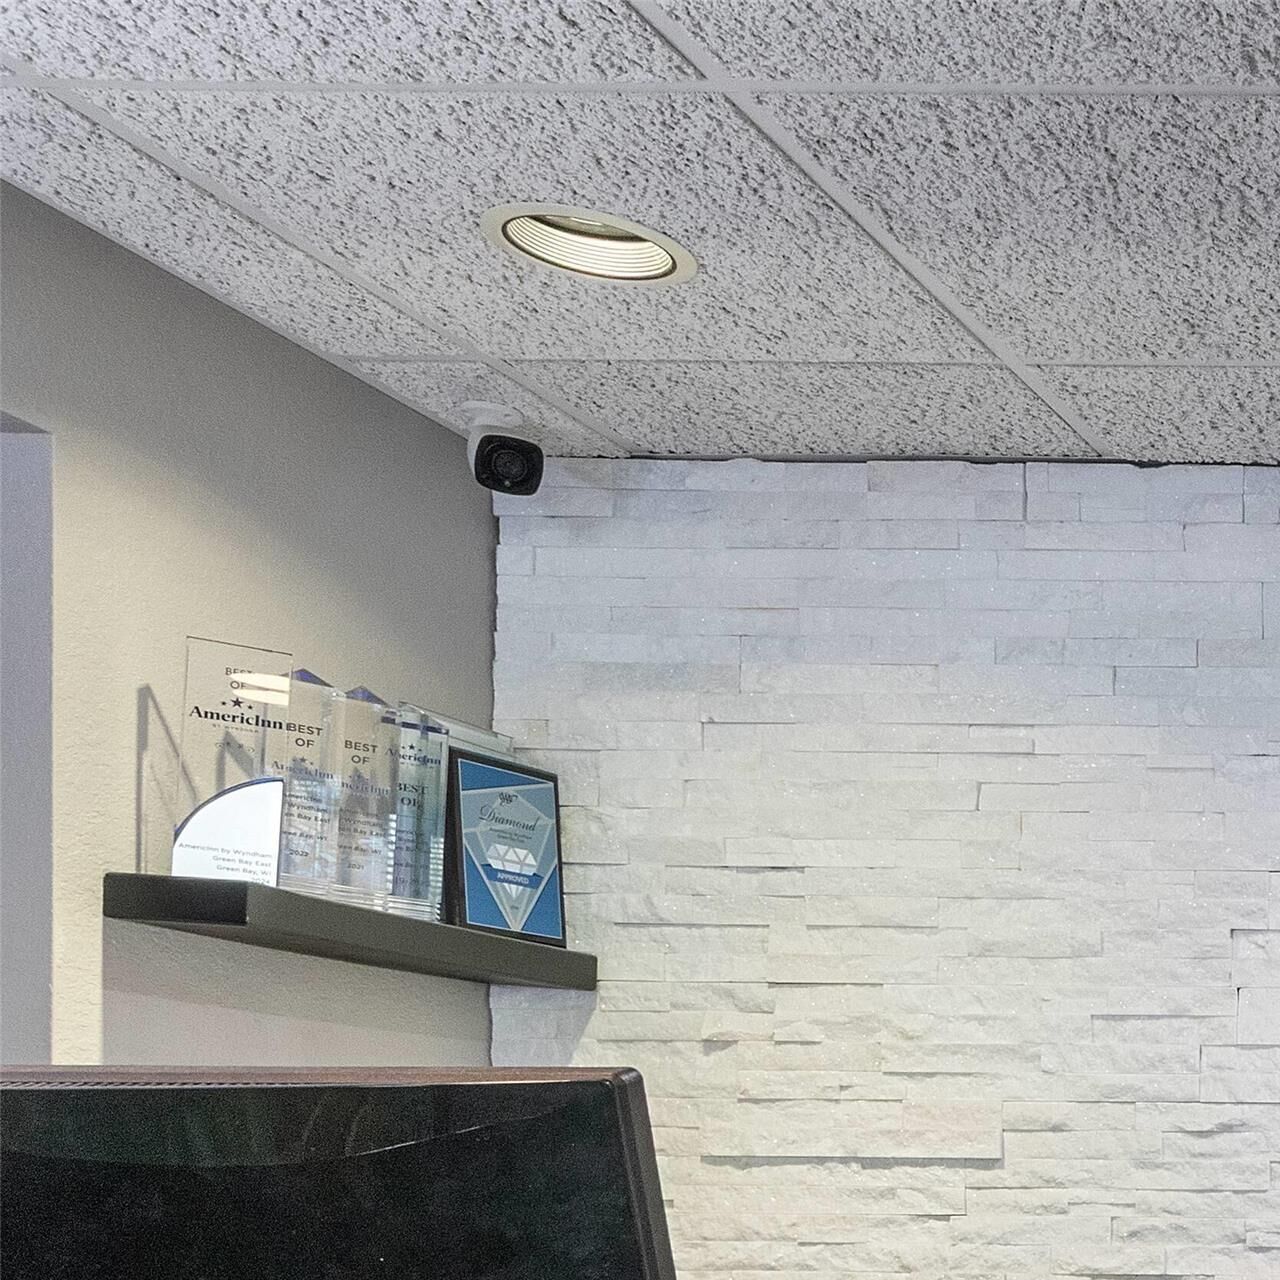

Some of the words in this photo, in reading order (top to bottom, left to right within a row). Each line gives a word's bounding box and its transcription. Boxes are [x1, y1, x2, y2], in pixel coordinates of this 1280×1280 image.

[189, 706, 284, 730] AmericInn
[286, 722, 323, 736] BEST
[295, 738, 315, 748] OF
[344, 740, 378, 753] BEST
[351, 755, 370, 765] OF
[478, 804, 540, 833] Diamond
